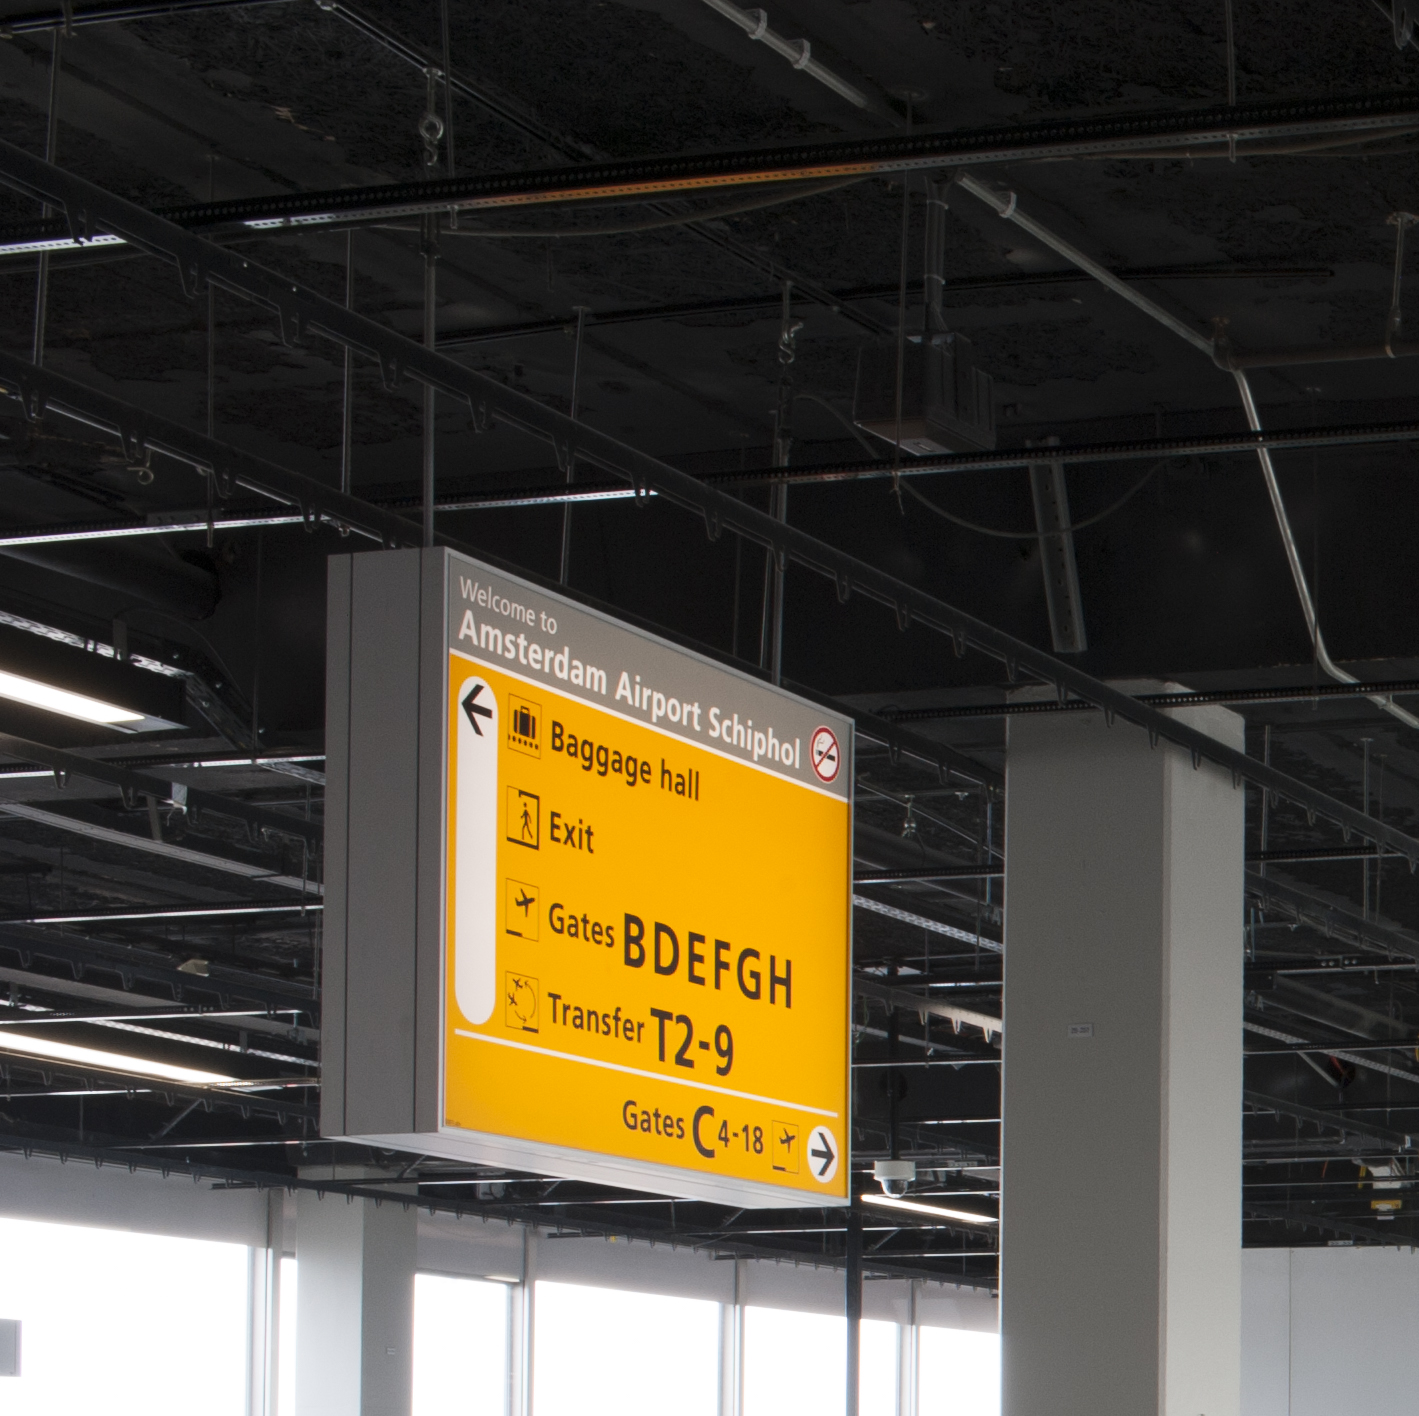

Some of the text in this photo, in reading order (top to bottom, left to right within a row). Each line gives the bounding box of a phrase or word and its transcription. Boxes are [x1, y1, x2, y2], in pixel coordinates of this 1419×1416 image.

[459, 575, 558, 635] Welcome to
[458, 609, 800, 770] Amsterdam Airport Schiphol
[550, 720, 700, 800] Baggage hall
[549, 811, 595, 855] Exit
[548, 902, 615, 949] Gates
[547, 992, 734, 1077] Transfer T2-9
[622, 1100, 685, 1140] Gates
